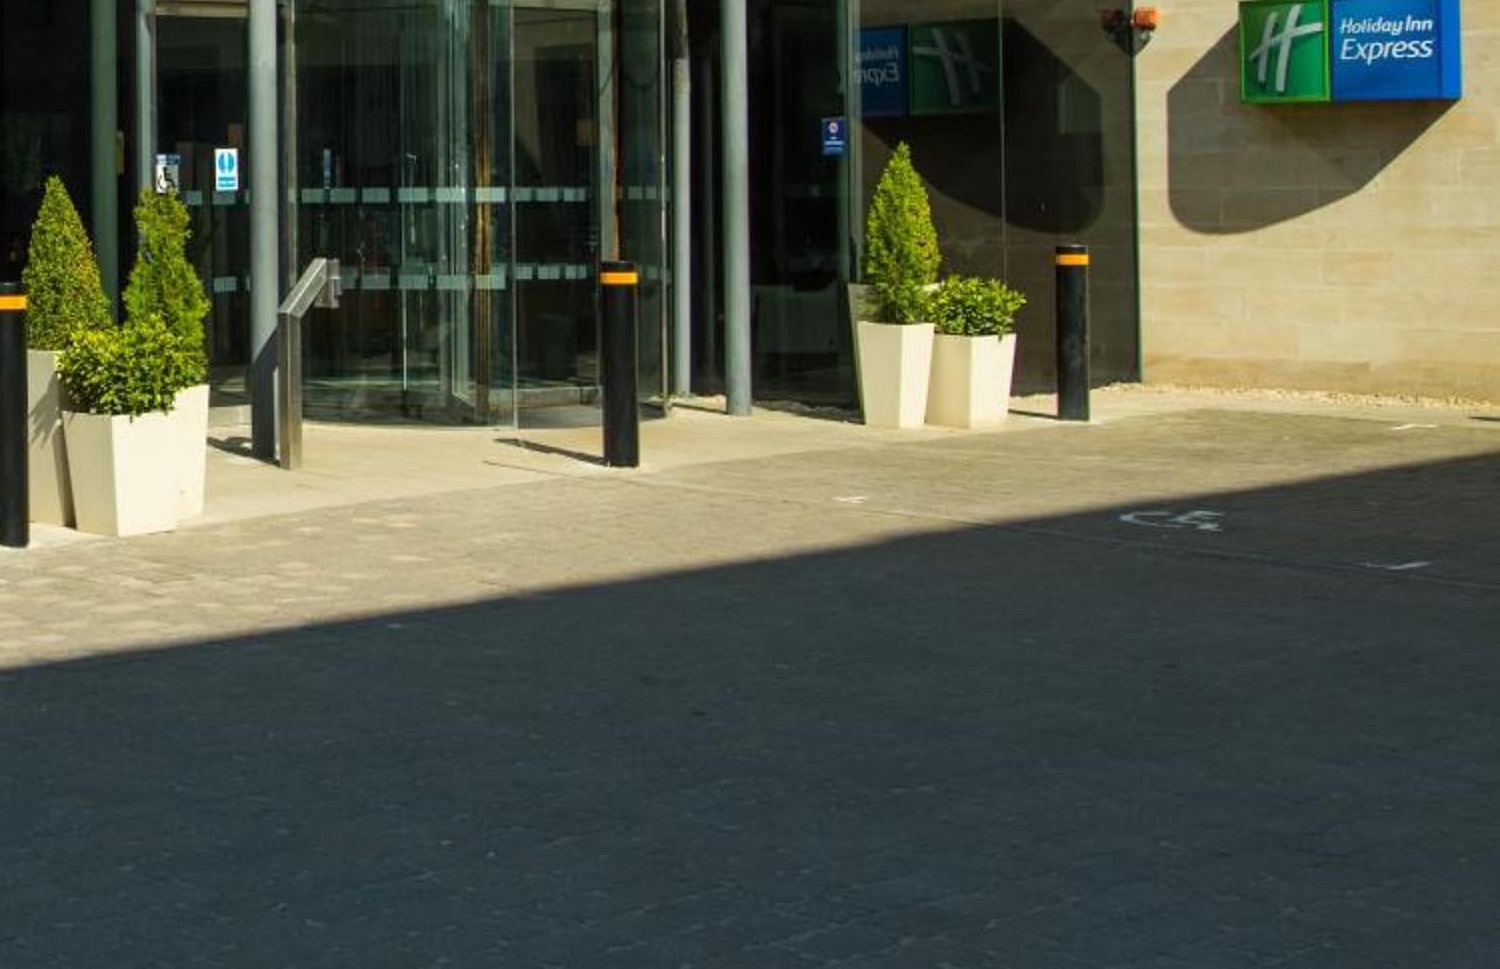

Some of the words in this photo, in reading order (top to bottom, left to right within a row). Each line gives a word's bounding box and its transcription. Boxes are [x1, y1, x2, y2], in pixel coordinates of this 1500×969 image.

[1340, 16, 1403, 36] Holiday
[1405, 14, 1433, 32] Inn
[1340, 38, 1435, 65] Express
